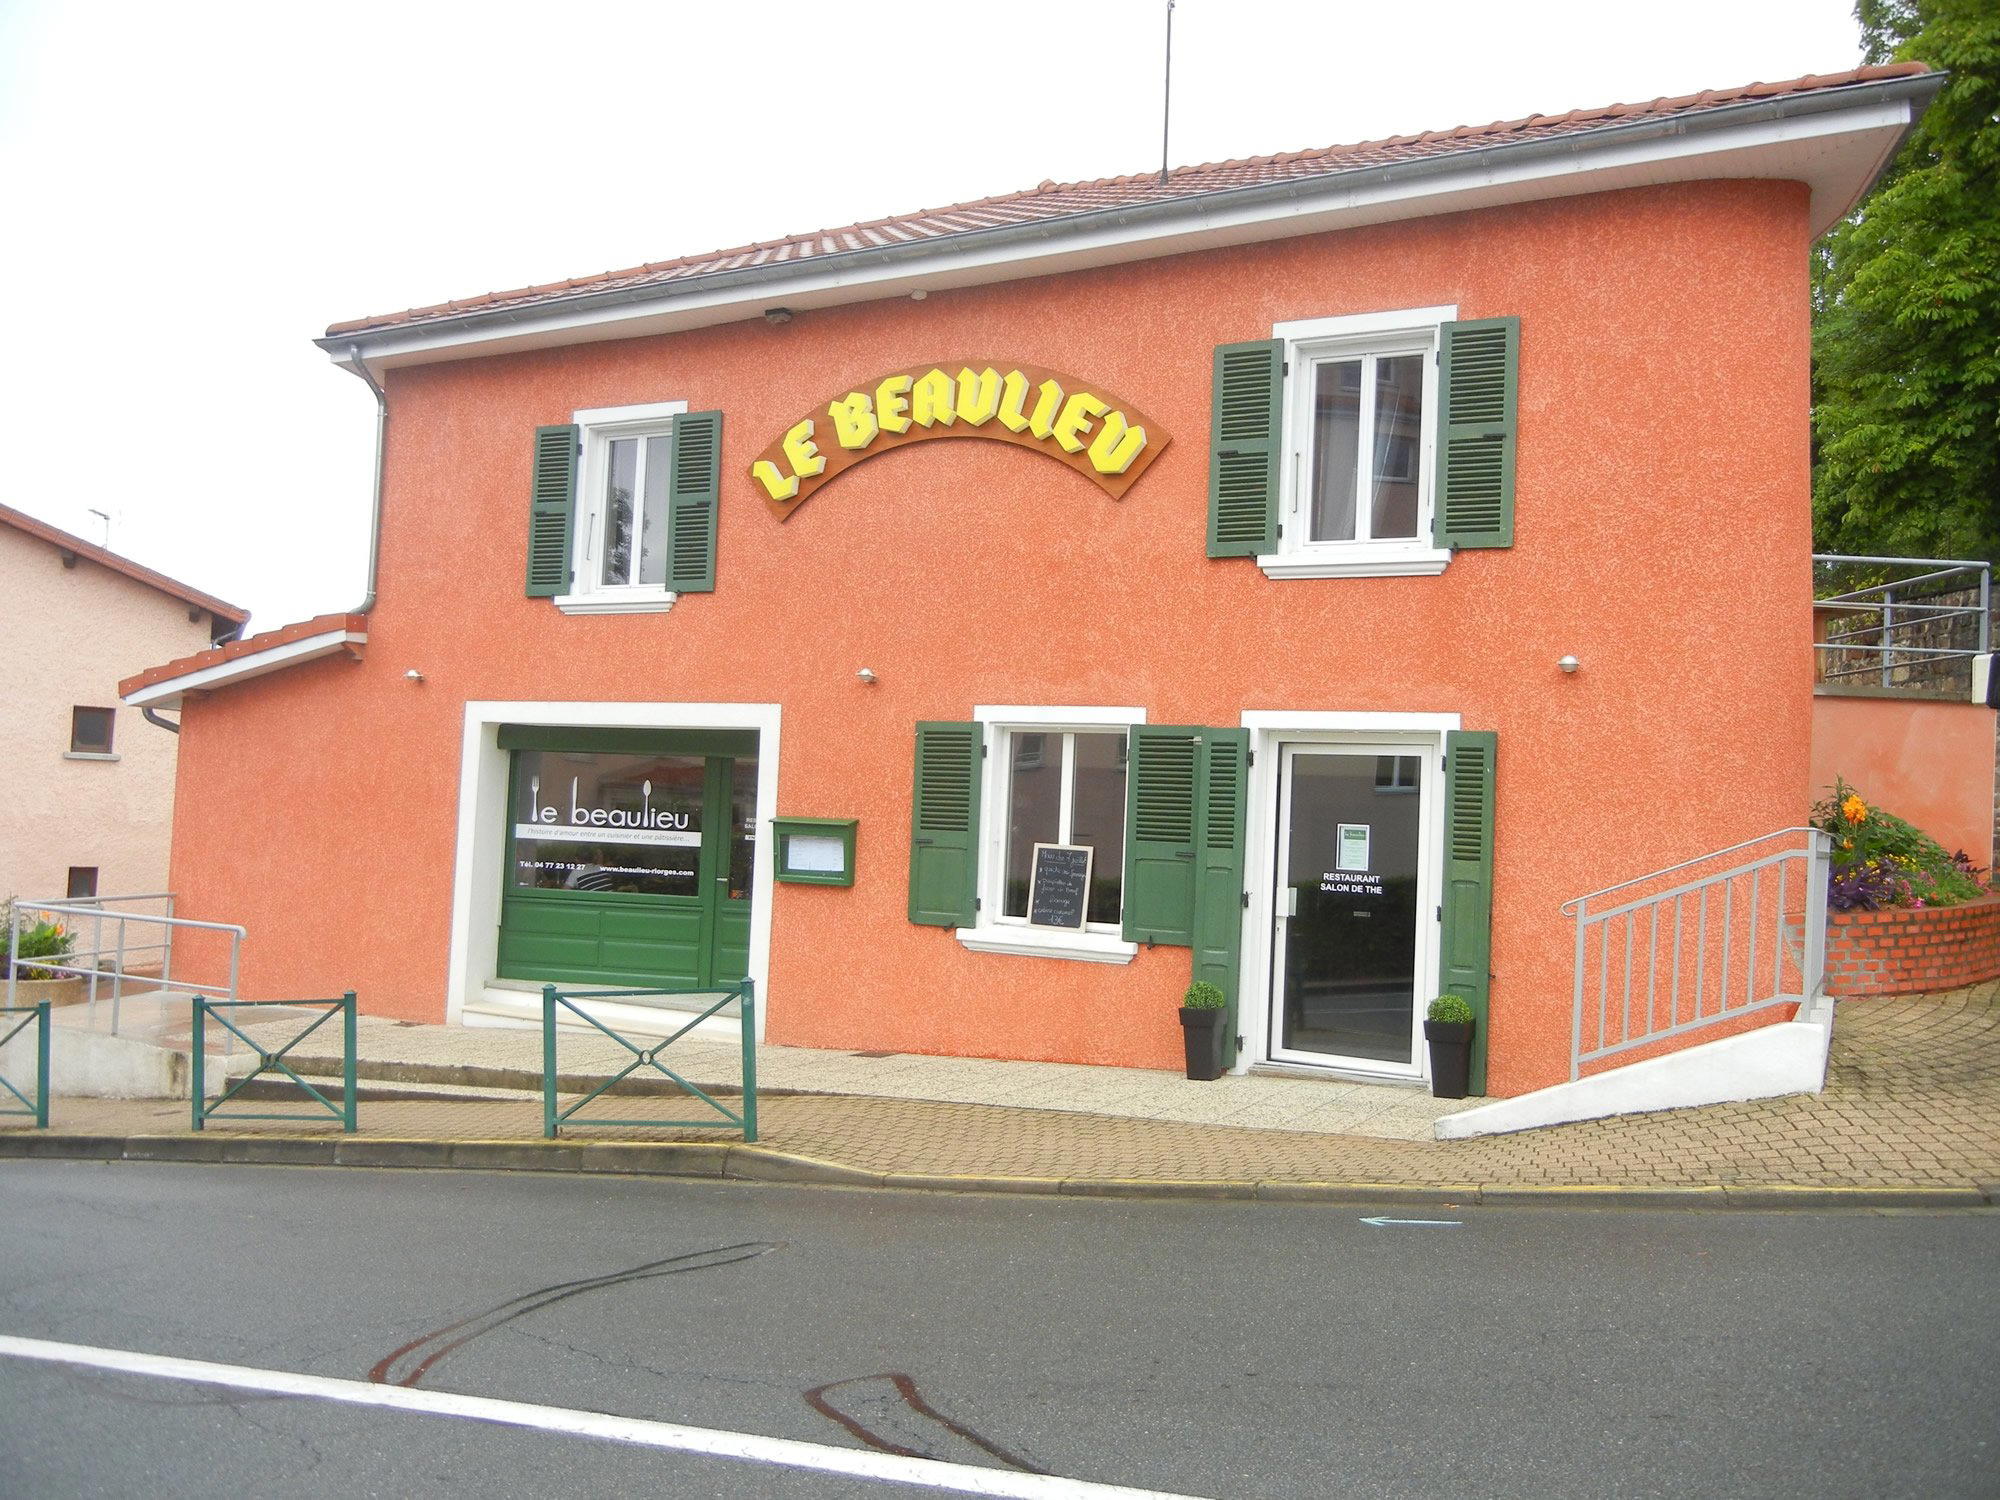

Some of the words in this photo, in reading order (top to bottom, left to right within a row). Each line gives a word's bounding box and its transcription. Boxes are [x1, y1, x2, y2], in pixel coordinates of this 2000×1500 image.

[752, 418, 827, 500] LE
[828, 366, 1148, 475] BEAULIEU
[531, 775, 558, 823] le
[571, 776, 690, 830] beaulieu
[520, 860, 533, 868] Tél.
[534, 861, 544, 869] 04
[599, 866, 694, 876] www.beaulieu-riorges.com
[1323, 872, 1381, 884] RESTAURANT
[1320, 883, 1350, 892] SALON
[1351, 884, 1363, 893] DE
[1365, 885, 1383, 894] THE
